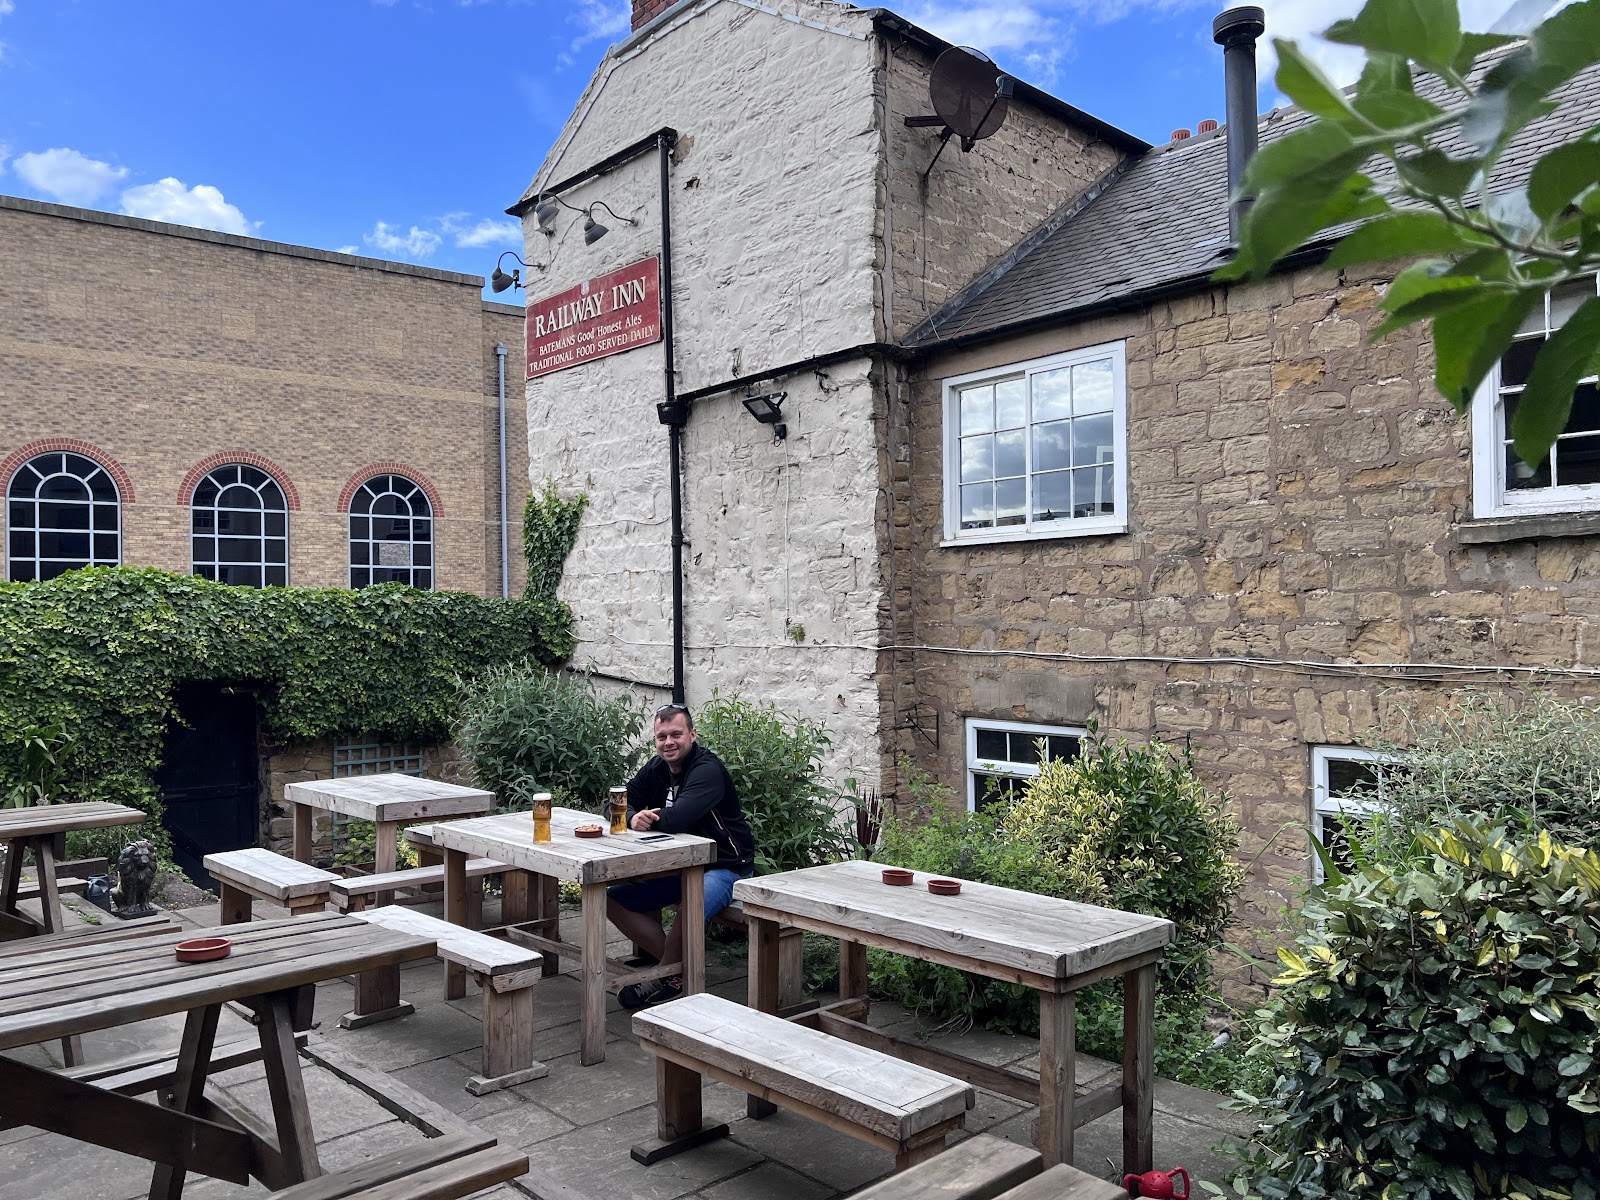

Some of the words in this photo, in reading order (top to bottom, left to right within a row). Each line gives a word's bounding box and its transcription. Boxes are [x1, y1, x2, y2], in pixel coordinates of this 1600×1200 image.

[535, 291, 604, 338] RAILWAY
[612, 276, 646, 311] INN
[529, 353, 574, 373] TRADITIONAL
[576, 343, 595, 358] FOOD
[597, 333, 628, 351] SERVED
[630, 325, 655, 342] DAILY
[539, 336, 575, 356] BATEMANS
[577, 327, 595, 343] Good
[597, 321, 622, 337] Honest
[625, 314, 642, 327] Ales
